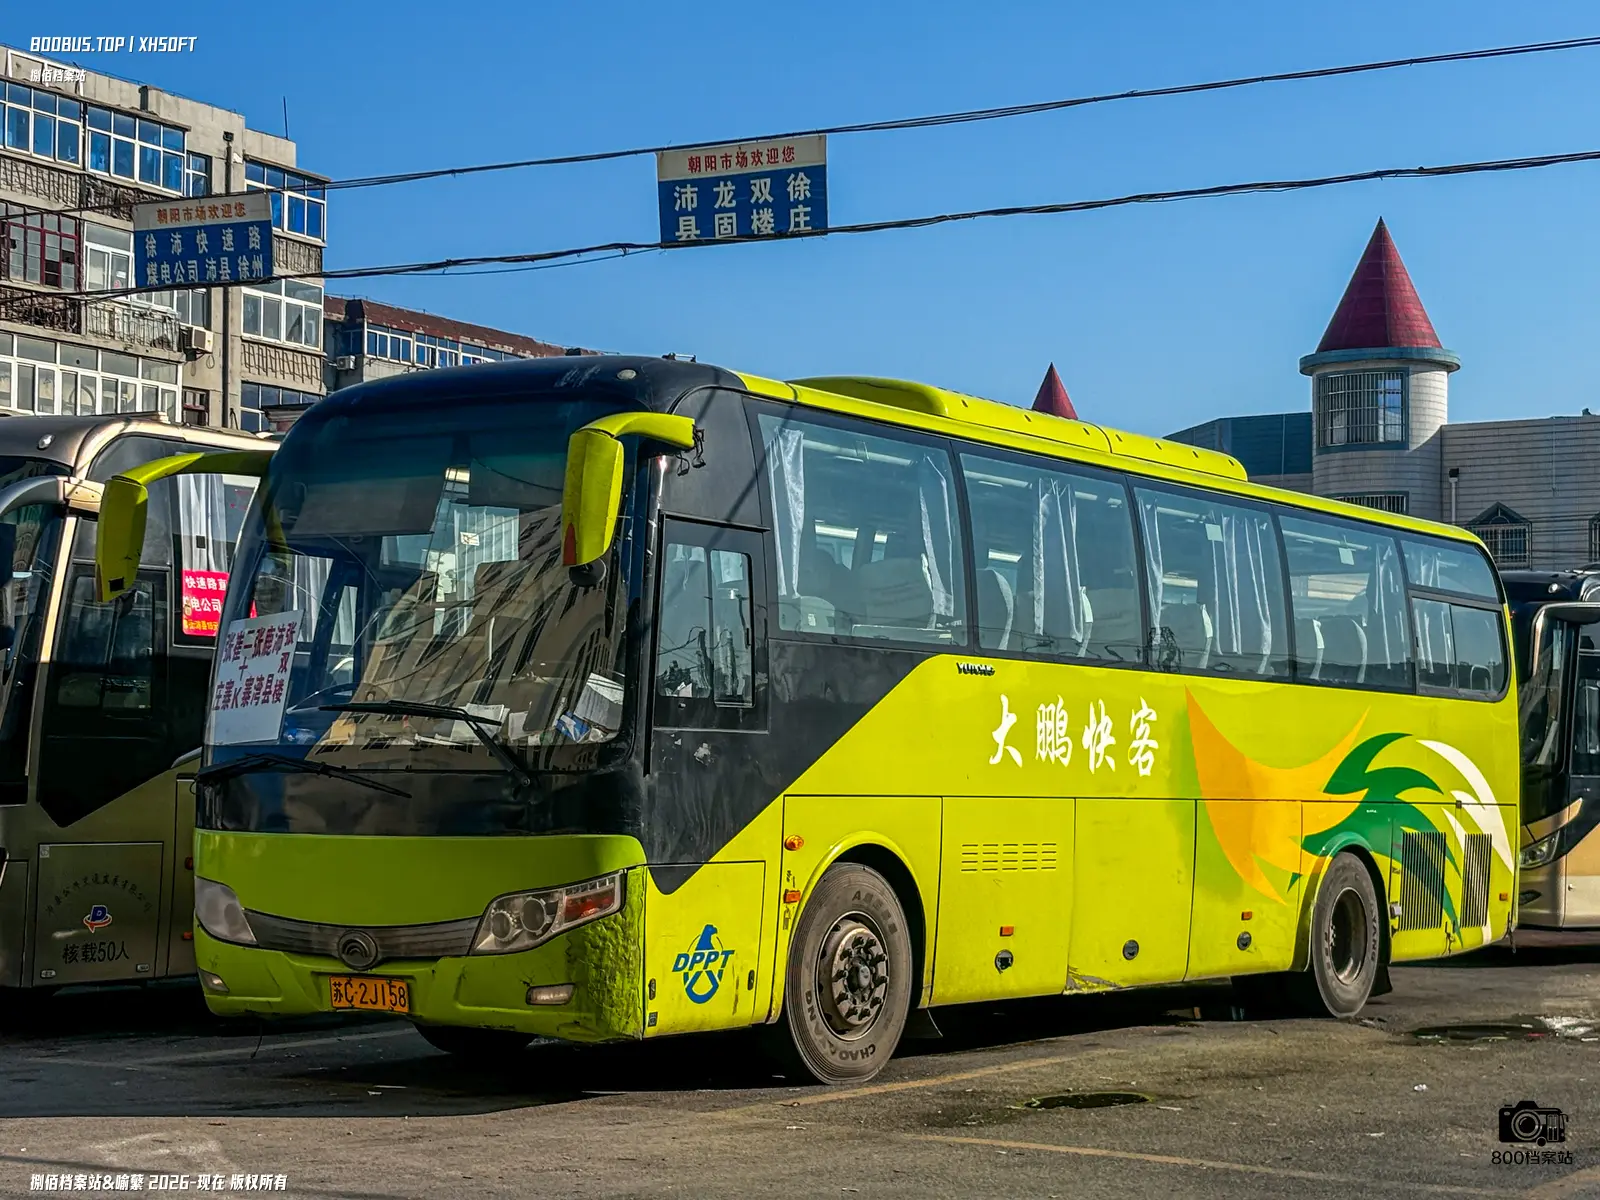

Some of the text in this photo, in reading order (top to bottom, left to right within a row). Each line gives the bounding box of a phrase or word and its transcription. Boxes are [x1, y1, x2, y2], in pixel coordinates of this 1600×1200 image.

[688, 145, 795, 173] 朝阳市场欢迎您
[156, 201, 247, 224] 朝阳市场欢迎您
[145, 225, 261, 258] 徐沛快速路
[147, 254, 263, 286] 煤电公司 沛县 徐州
[989, 693, 1159, 776] 大鹏快客
[62, 941, 130, 965] 核载50人
[671, 949, 735, 972] DPPT
